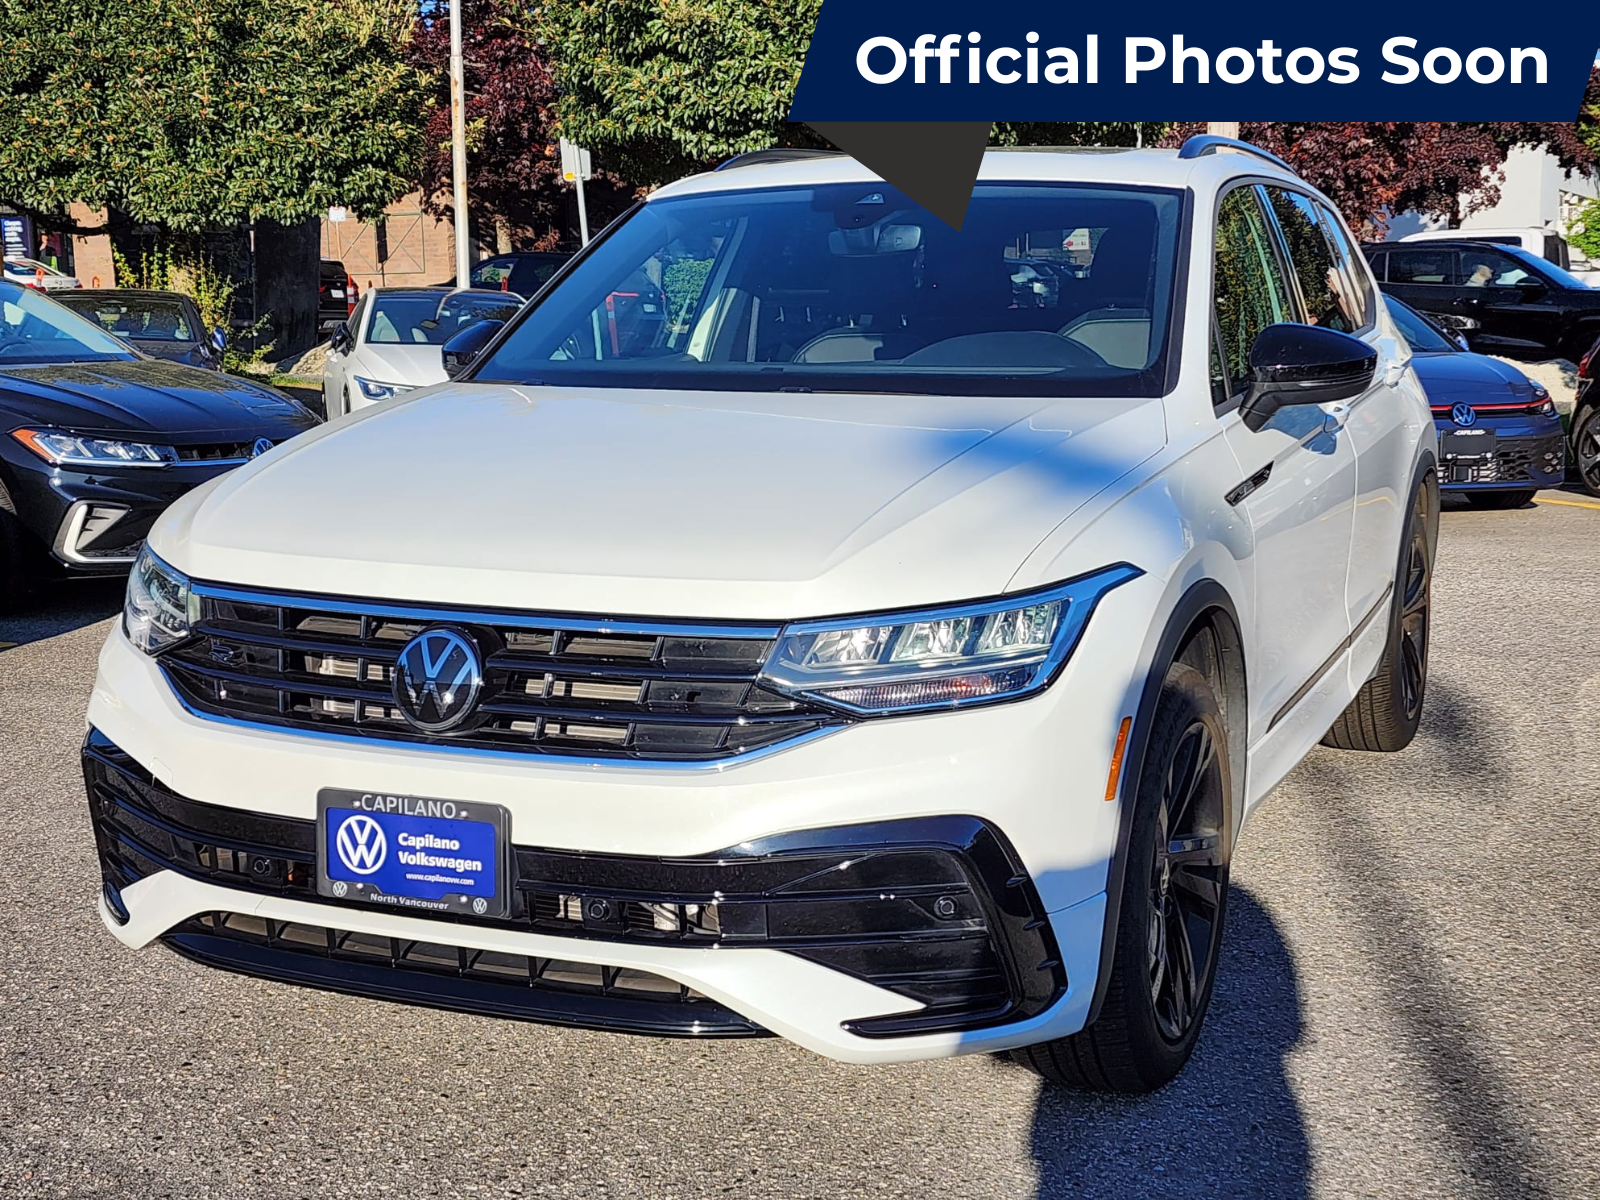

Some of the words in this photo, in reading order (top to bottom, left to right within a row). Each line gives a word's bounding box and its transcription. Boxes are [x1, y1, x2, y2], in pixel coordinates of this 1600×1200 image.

[361, 794, 456, 819] CAPILANO
[398, 832, 460, 850] Capilano
[398, 851, 482, 872] Volkswagen
[405, 873, 475, 886] www.capilanovw.com
[370, 893, 397, 904] North
[399, 896, 449, 910] Vancouver
